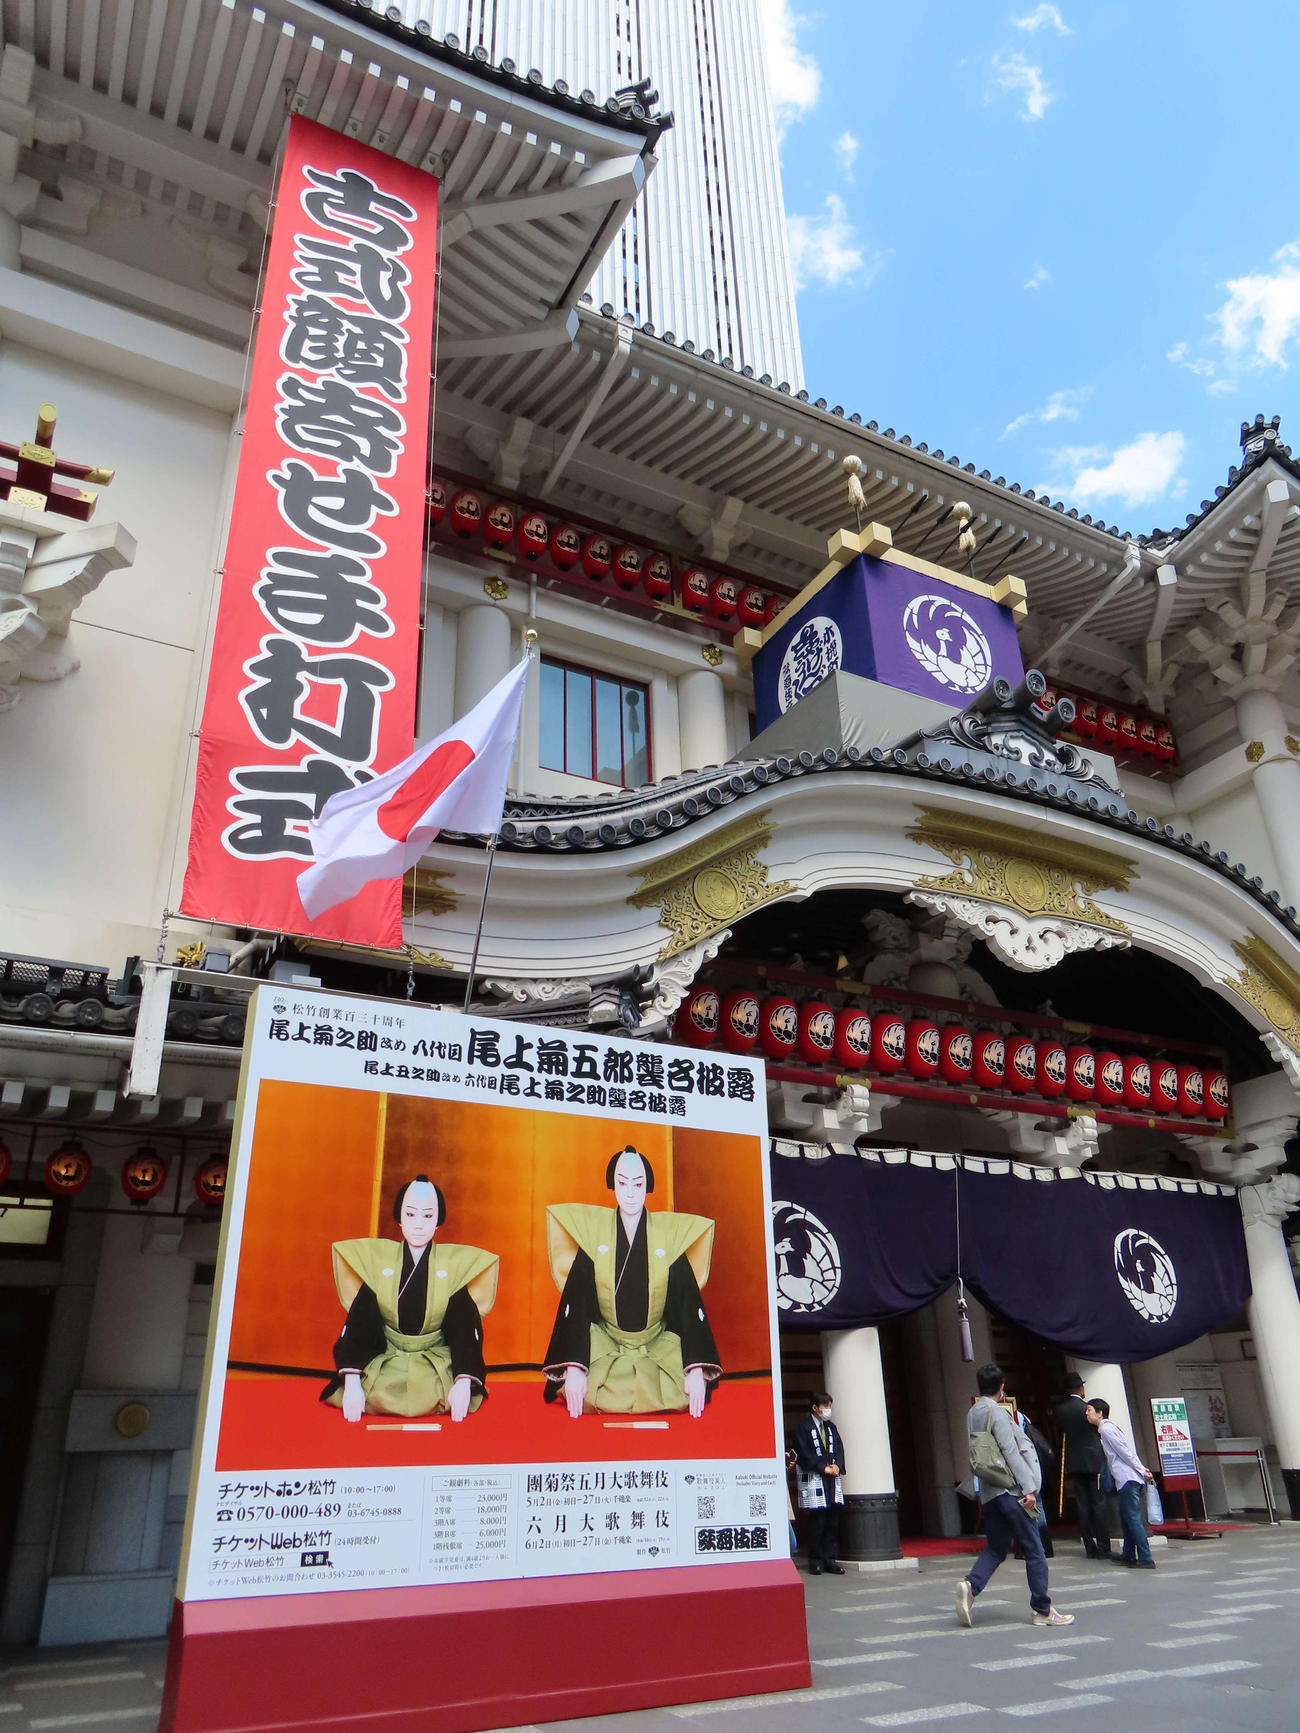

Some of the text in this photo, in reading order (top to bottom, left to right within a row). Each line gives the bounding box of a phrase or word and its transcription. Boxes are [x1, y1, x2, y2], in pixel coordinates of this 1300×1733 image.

[292, 1003, 406, 1029] 松竹創業百三十周年
[218, 1479, 337, 1500] チケットホン松竹
[527, 1470, 669, 1493] 團菊祭五月大歌舞伎
[477, 1493, 508, 1502] 23,000円
[236, 1502, 342, 1522] 0570-000-489
[347, 1507, 402, 1518] 03-6745-0888
[477, 1505, 508, 1514] 18,000円
[479, 1516, 507, 1525] 8,000円
[526, 1510, 670, 1535] 六月大歌舞伎
[479, 1528, 507, 1537] 6,000円
[212, 1529, 333, 1553] チケットWeb松竹
[475, 1540, 506, 1549] 25,000円
[212, 1555, 285, 1571] チケットWeb松竹
